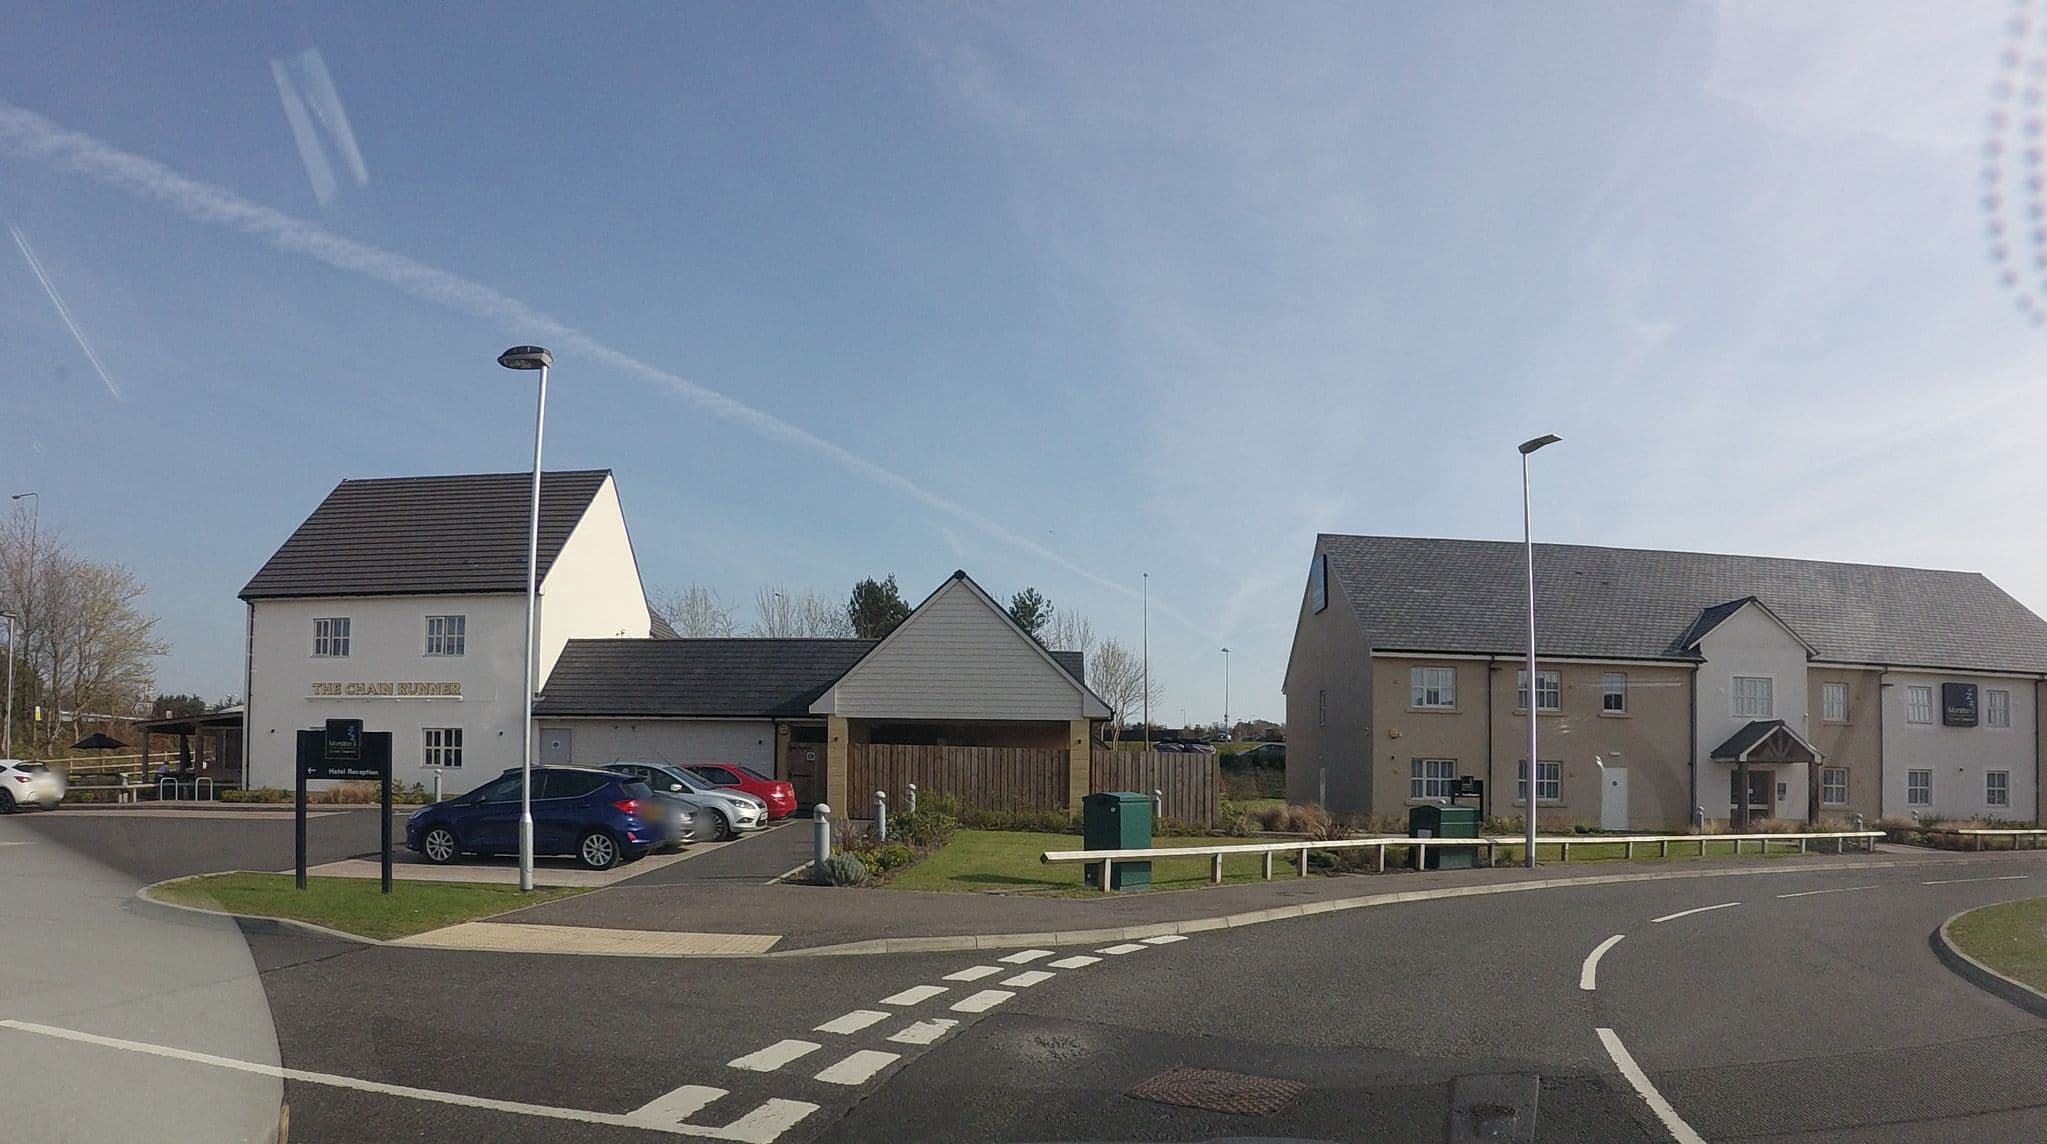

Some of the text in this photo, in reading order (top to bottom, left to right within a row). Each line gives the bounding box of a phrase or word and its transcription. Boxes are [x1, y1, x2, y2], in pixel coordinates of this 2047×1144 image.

[312, 682, 461, 696] THE CHAIN RUNNER
[347, 767, 379, 777] Reception
